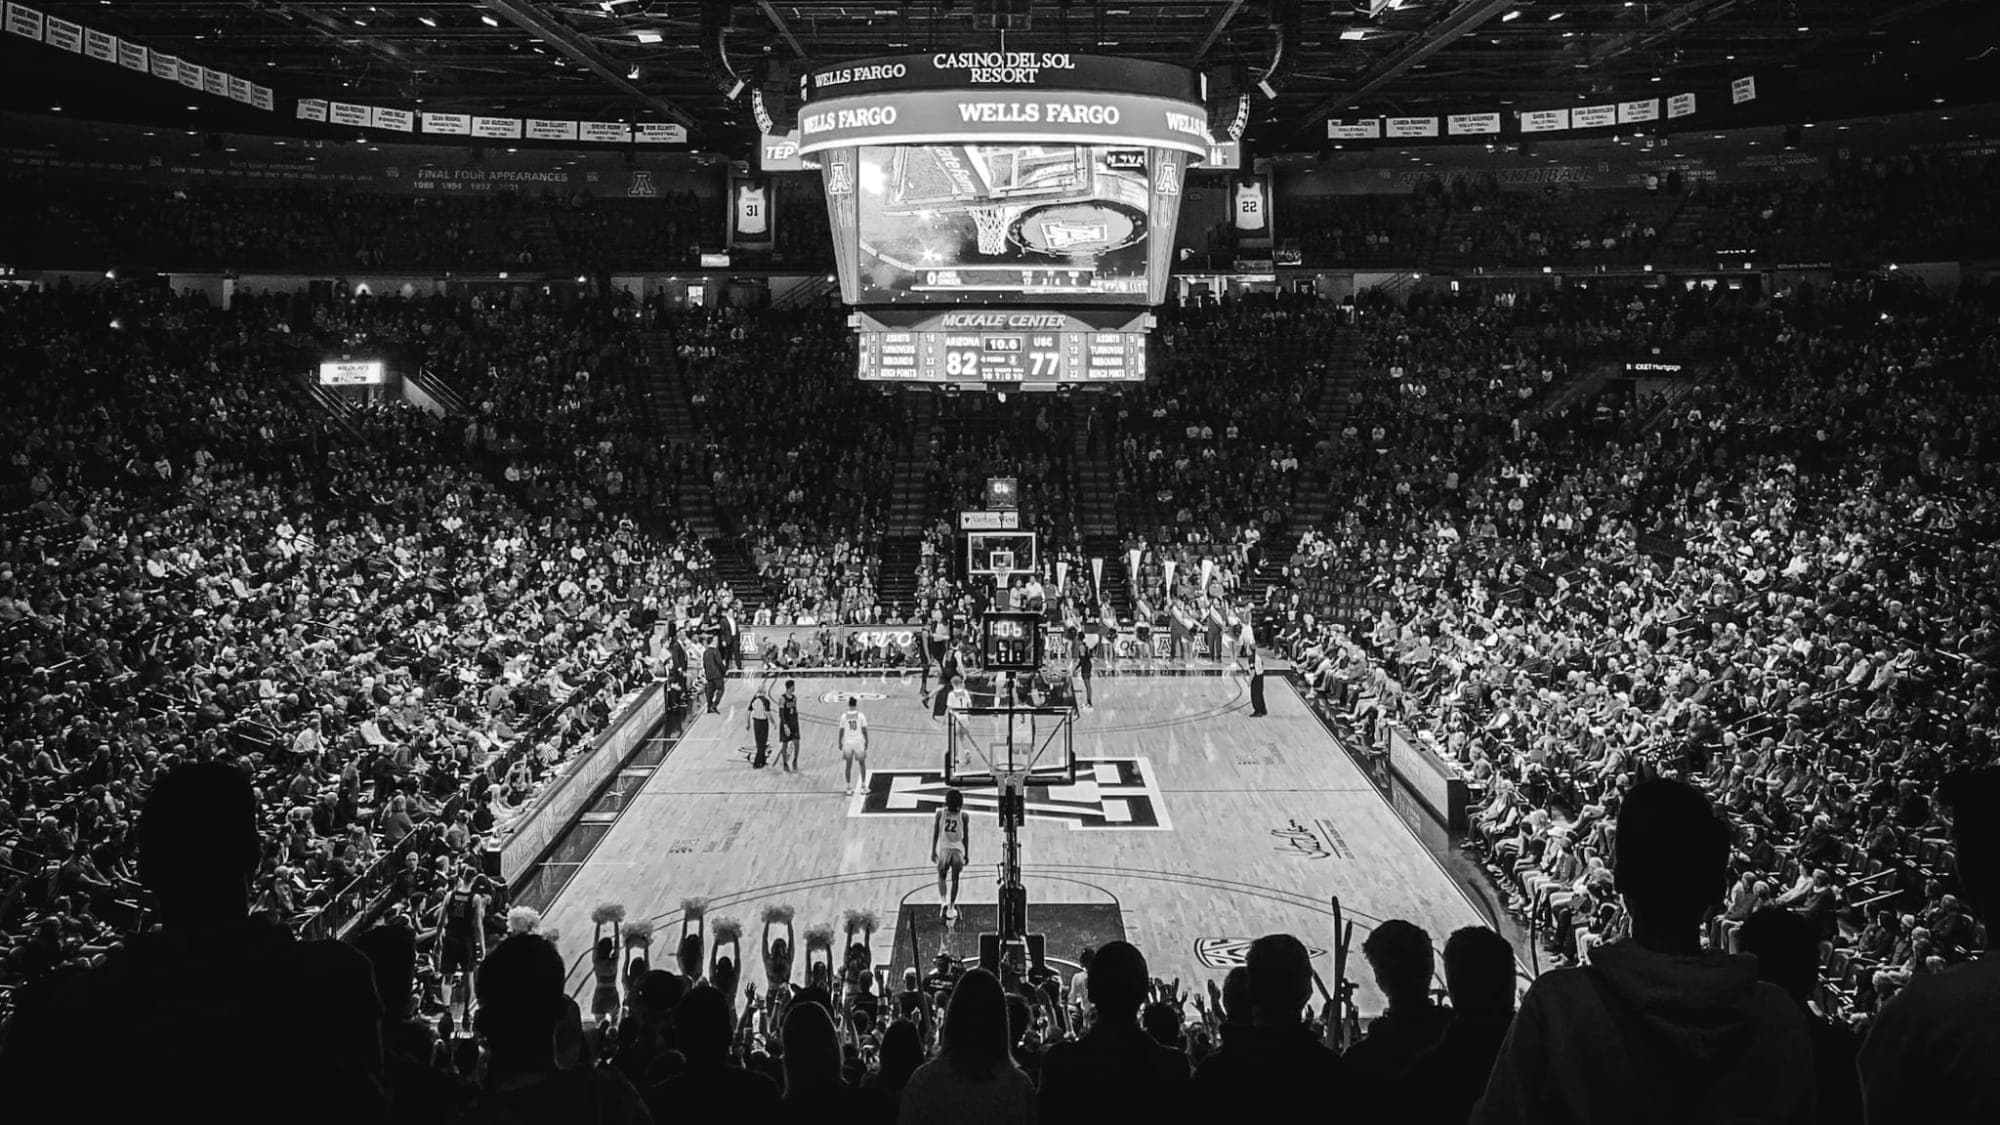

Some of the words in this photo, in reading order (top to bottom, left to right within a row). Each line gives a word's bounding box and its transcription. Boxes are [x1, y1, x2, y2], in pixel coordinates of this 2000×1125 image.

[933, 53, 1000, 69] CASINO
[1005, 53, 1040, 68] DEL
[1042, 54, 1075, 69] SOL
[814, 70, 852, 88] WELLS
[853, 64, 906, 82] FARGO
[970, 68, 1038, 84] RESORT
[838, 107, 897, 128] FARGO
[959, 103, 1040, 122] WELLS
[1046, 104, 1120, 125] FARGO
[1165, 112, 1200, 136] WELLS
[766, 146, 795, 160] TEP
[418, 169, 450, 180] FINAL
[455, 170, 485, 181] FOUR
[489, 171, 568, 182] APPEARANCES
[746, 205, 758, 216] 31
[1242, 201, 1257, 213] 22
[942, 315, 1006, 327] MCKALE
[1008, 315, 1066, 327] CENTER
[946, 336, 980, 347] ARIZONA
[1033, 336, 1053, 347] USC
[990, 339, 1018, 350] 10.6
[946, 351, 977, 376] 82
[1029, 351, 1059, 376] 77
[944, 819, 958, 833] 22
